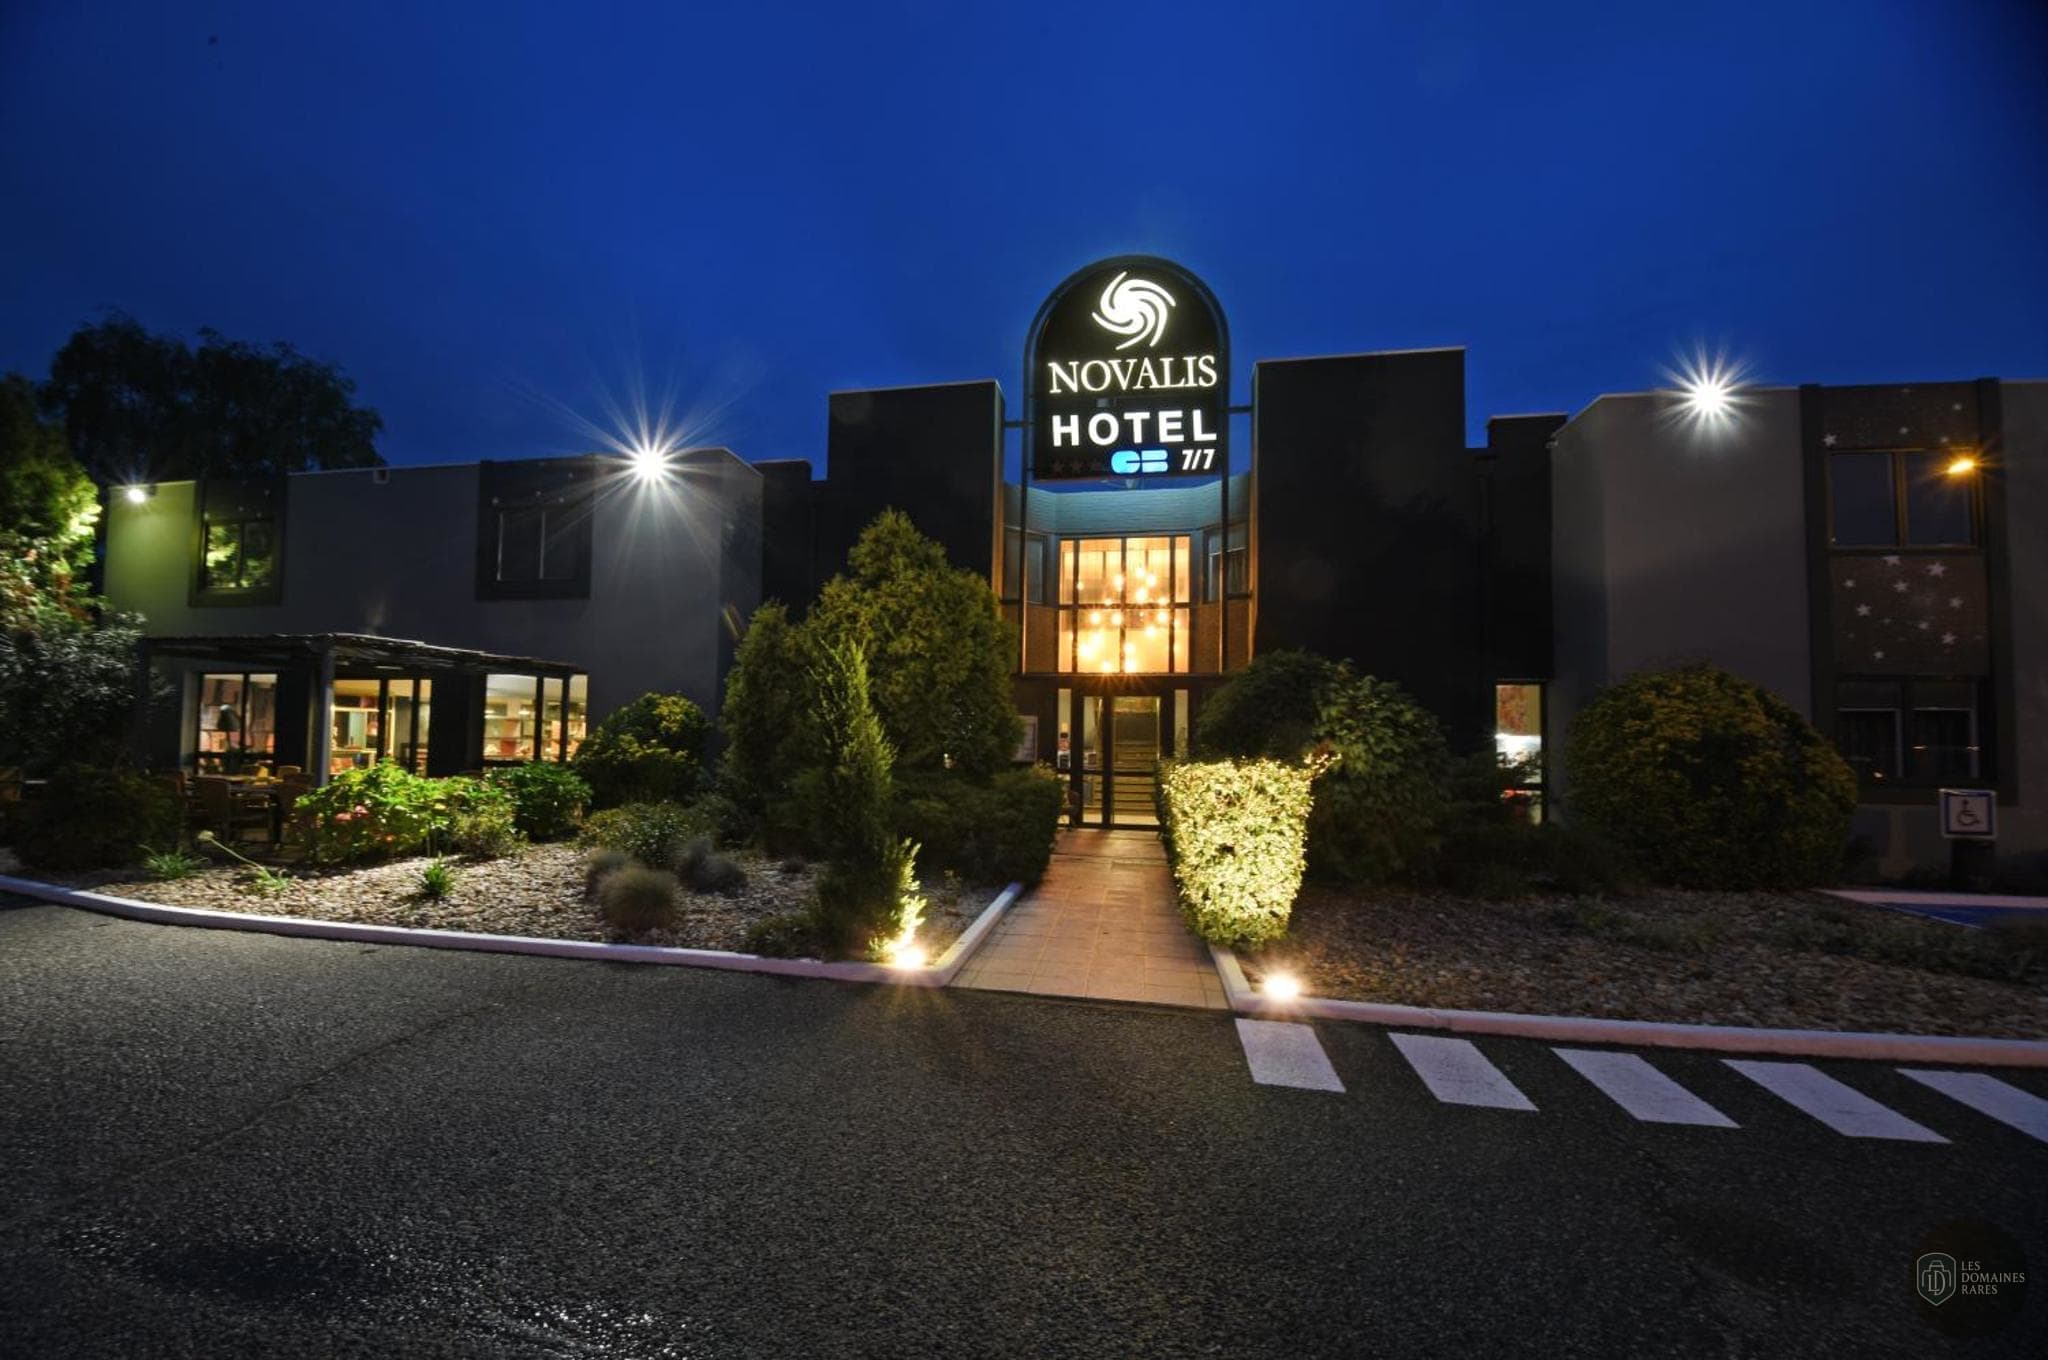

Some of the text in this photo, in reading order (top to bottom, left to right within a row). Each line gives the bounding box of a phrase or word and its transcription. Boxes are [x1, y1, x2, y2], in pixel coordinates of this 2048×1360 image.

[1048, 355, 1218, 393] NOVALIS
[1052, 409, 1217, 446] HOTEL
[1181, 449, 1215, 470] 7/7
